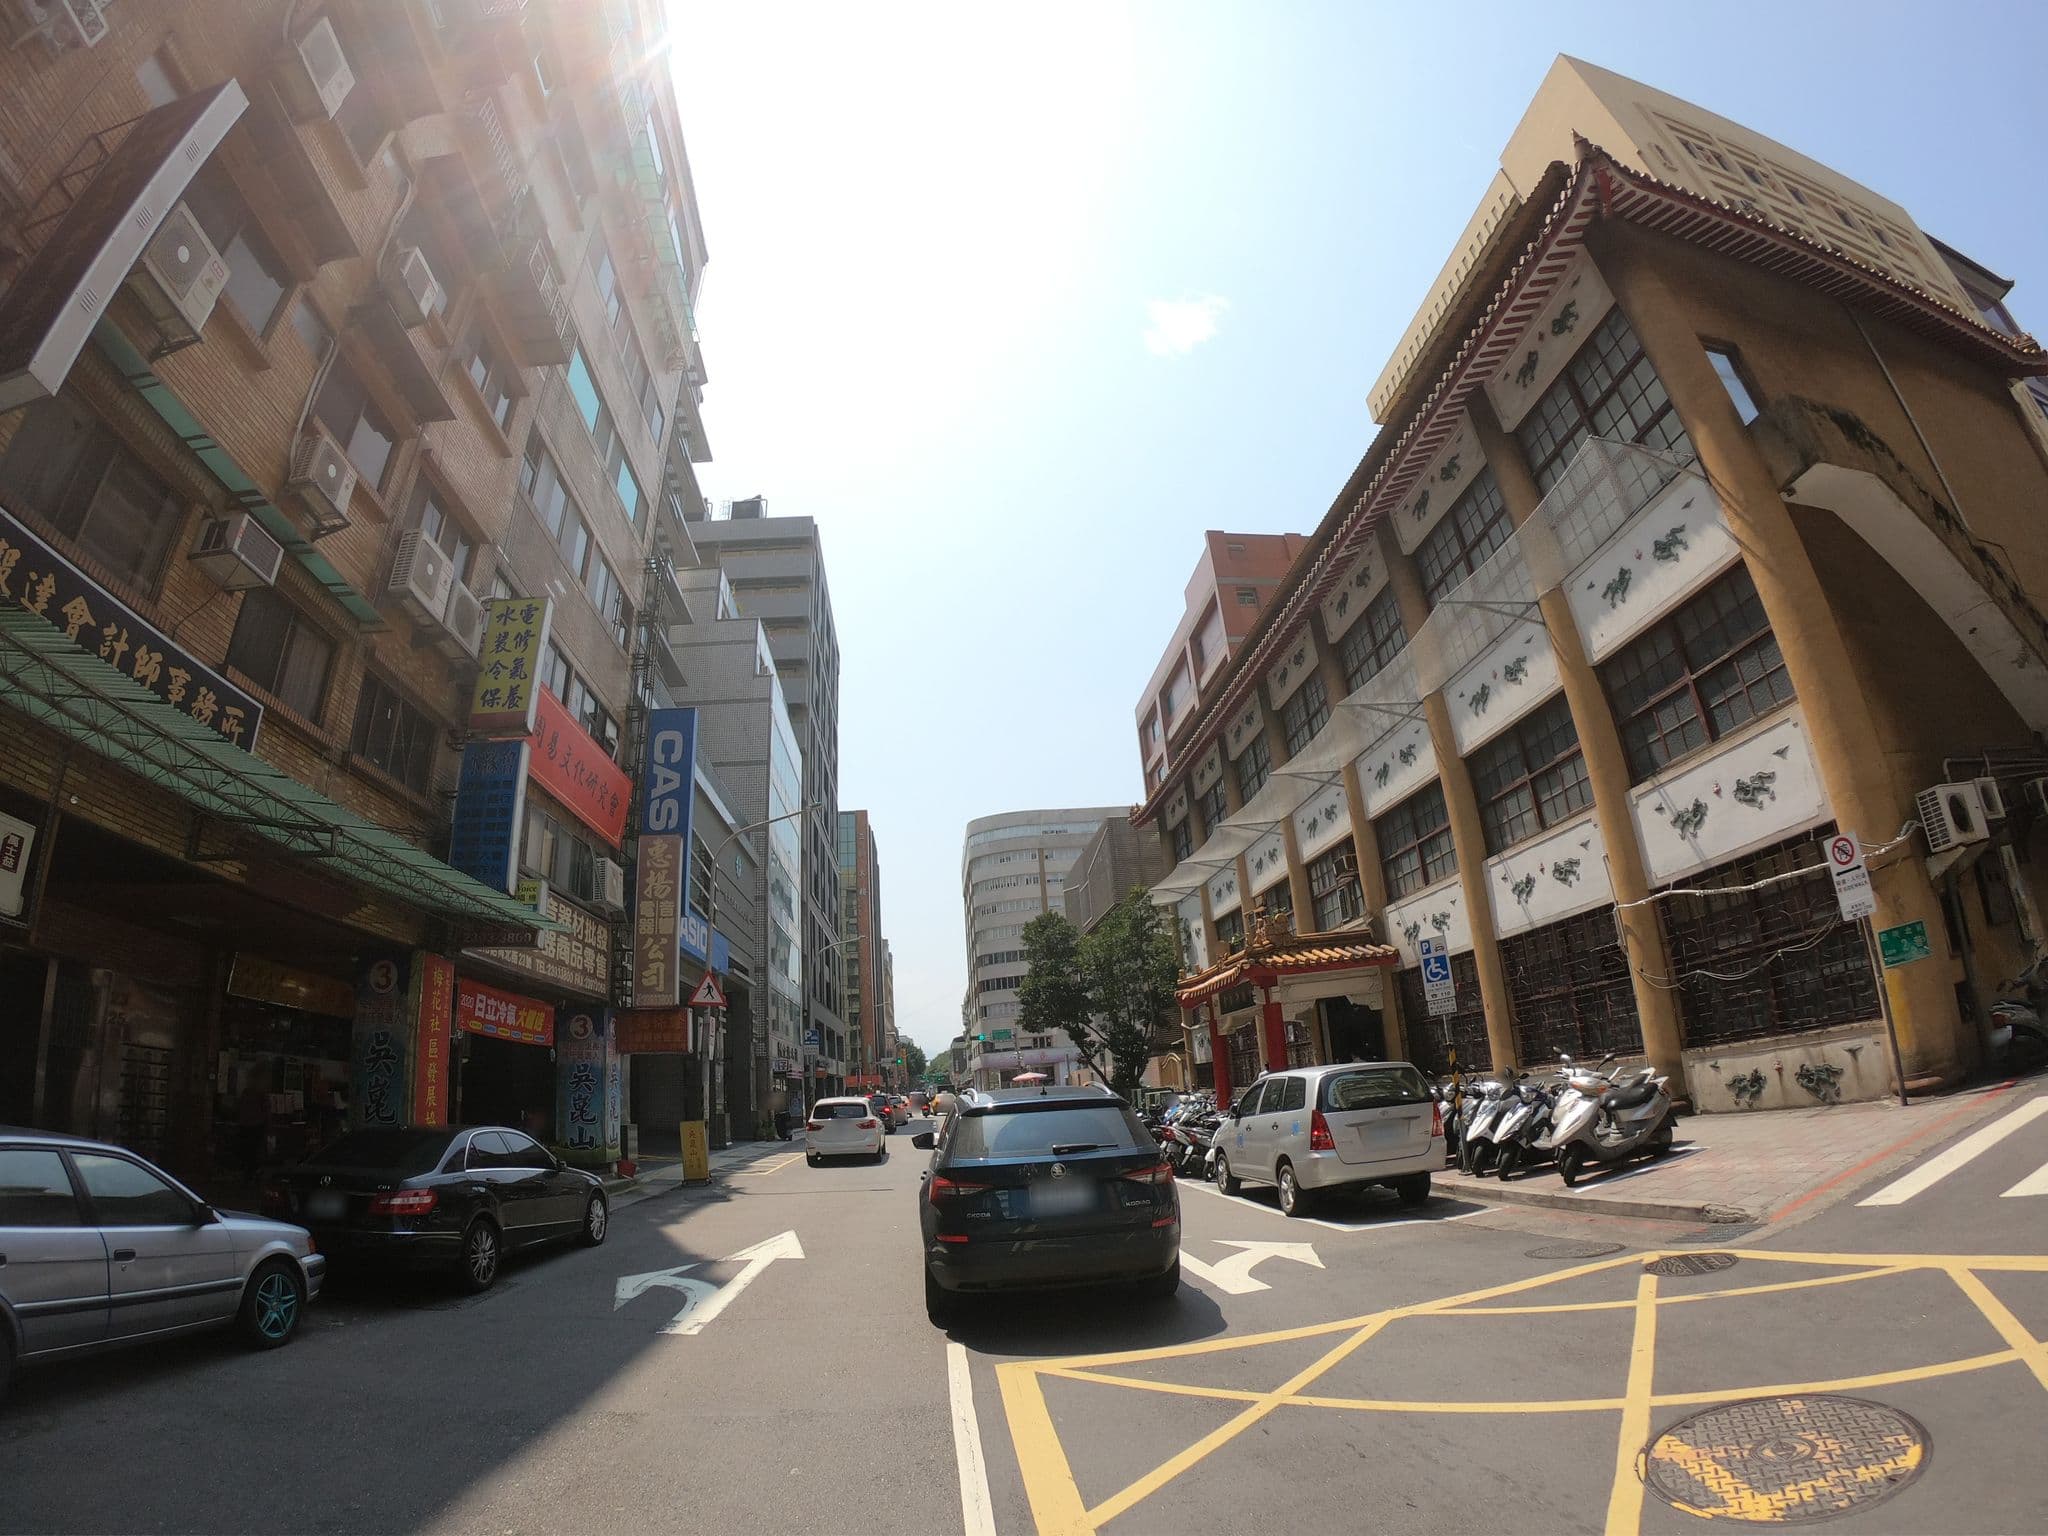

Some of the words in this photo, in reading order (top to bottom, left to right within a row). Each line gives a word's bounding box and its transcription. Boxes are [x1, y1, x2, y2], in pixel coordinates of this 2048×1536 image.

[496, 604, 539, 625] 水電
[490, 630, 535, 653] 裝修
[485, 657, 528, 680] 冷氣
[480, 685, 523, 709] 保養
[533, 715, 619, 818] 周易文化研究會
[649, 729, 684, 831] CAS
[679, 917, 708, 956] ASIO
[1422, 942, 1430, 954] P
[640, 937, 669, 993] 公司
